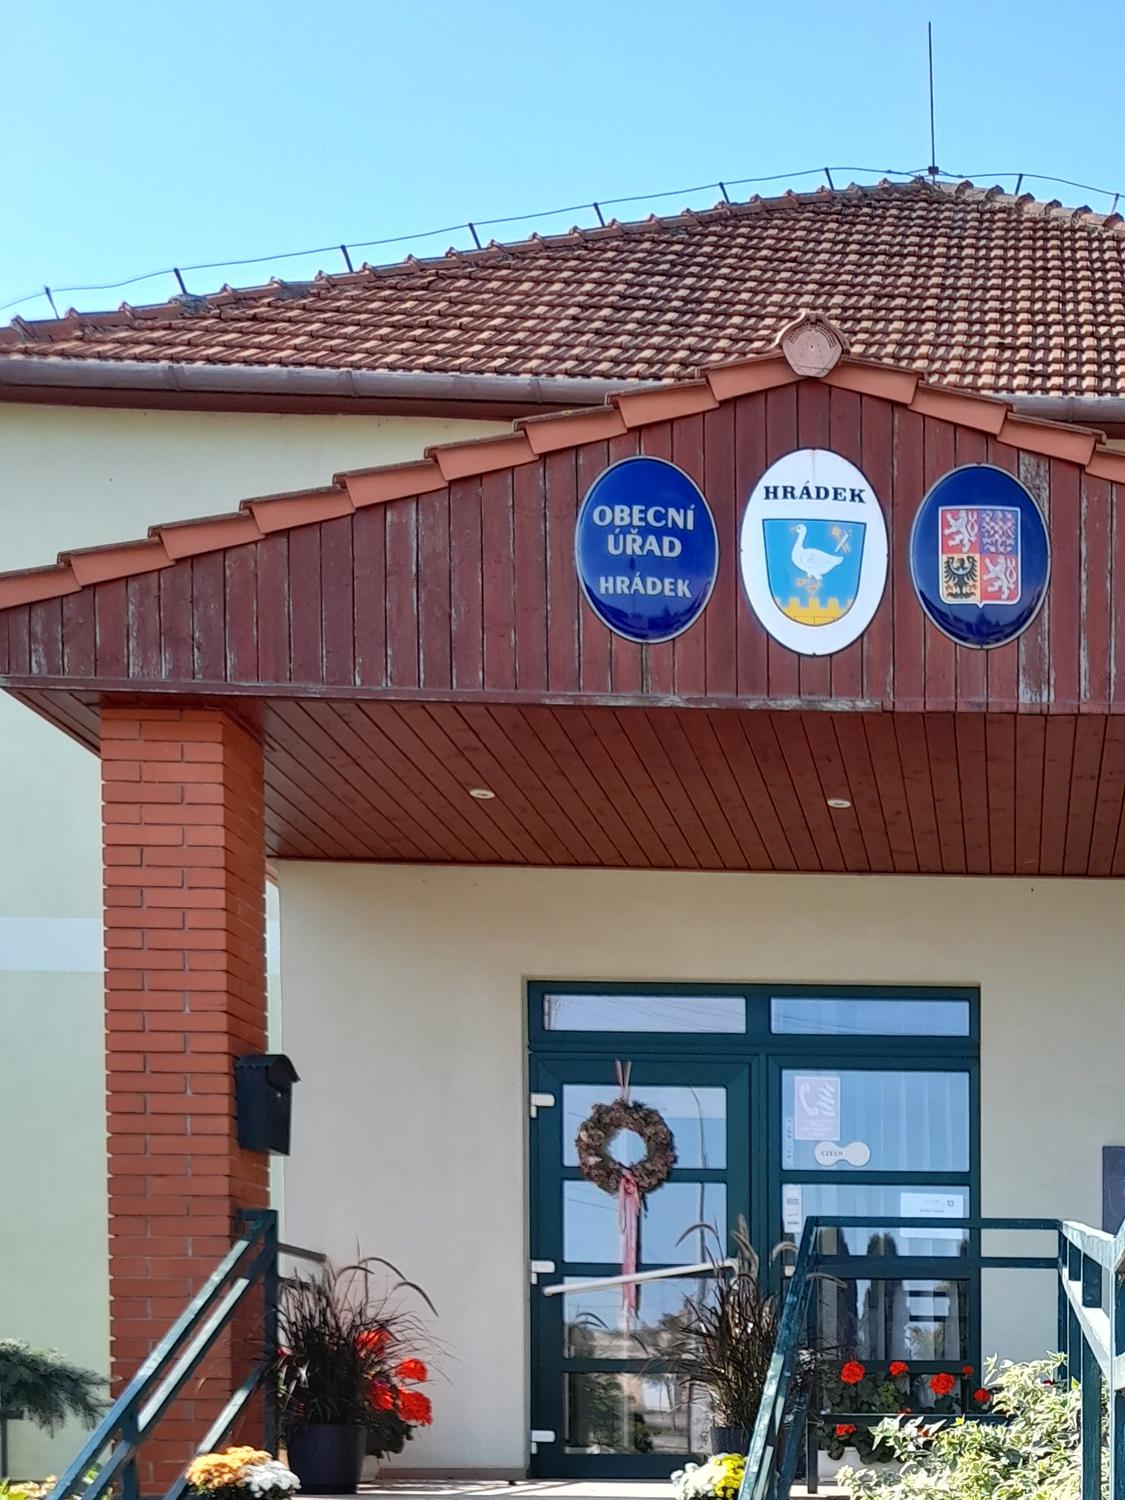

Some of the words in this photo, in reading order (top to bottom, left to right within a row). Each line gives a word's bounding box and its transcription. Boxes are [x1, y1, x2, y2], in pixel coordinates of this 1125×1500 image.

[763, 480, 866, 504] HRÁDEK
[593, 504, 696, 531] OBECNÍ
[607, 528, 682, 557] ÚŘAD
[600, 571, 692, 598] HRÁDEK
